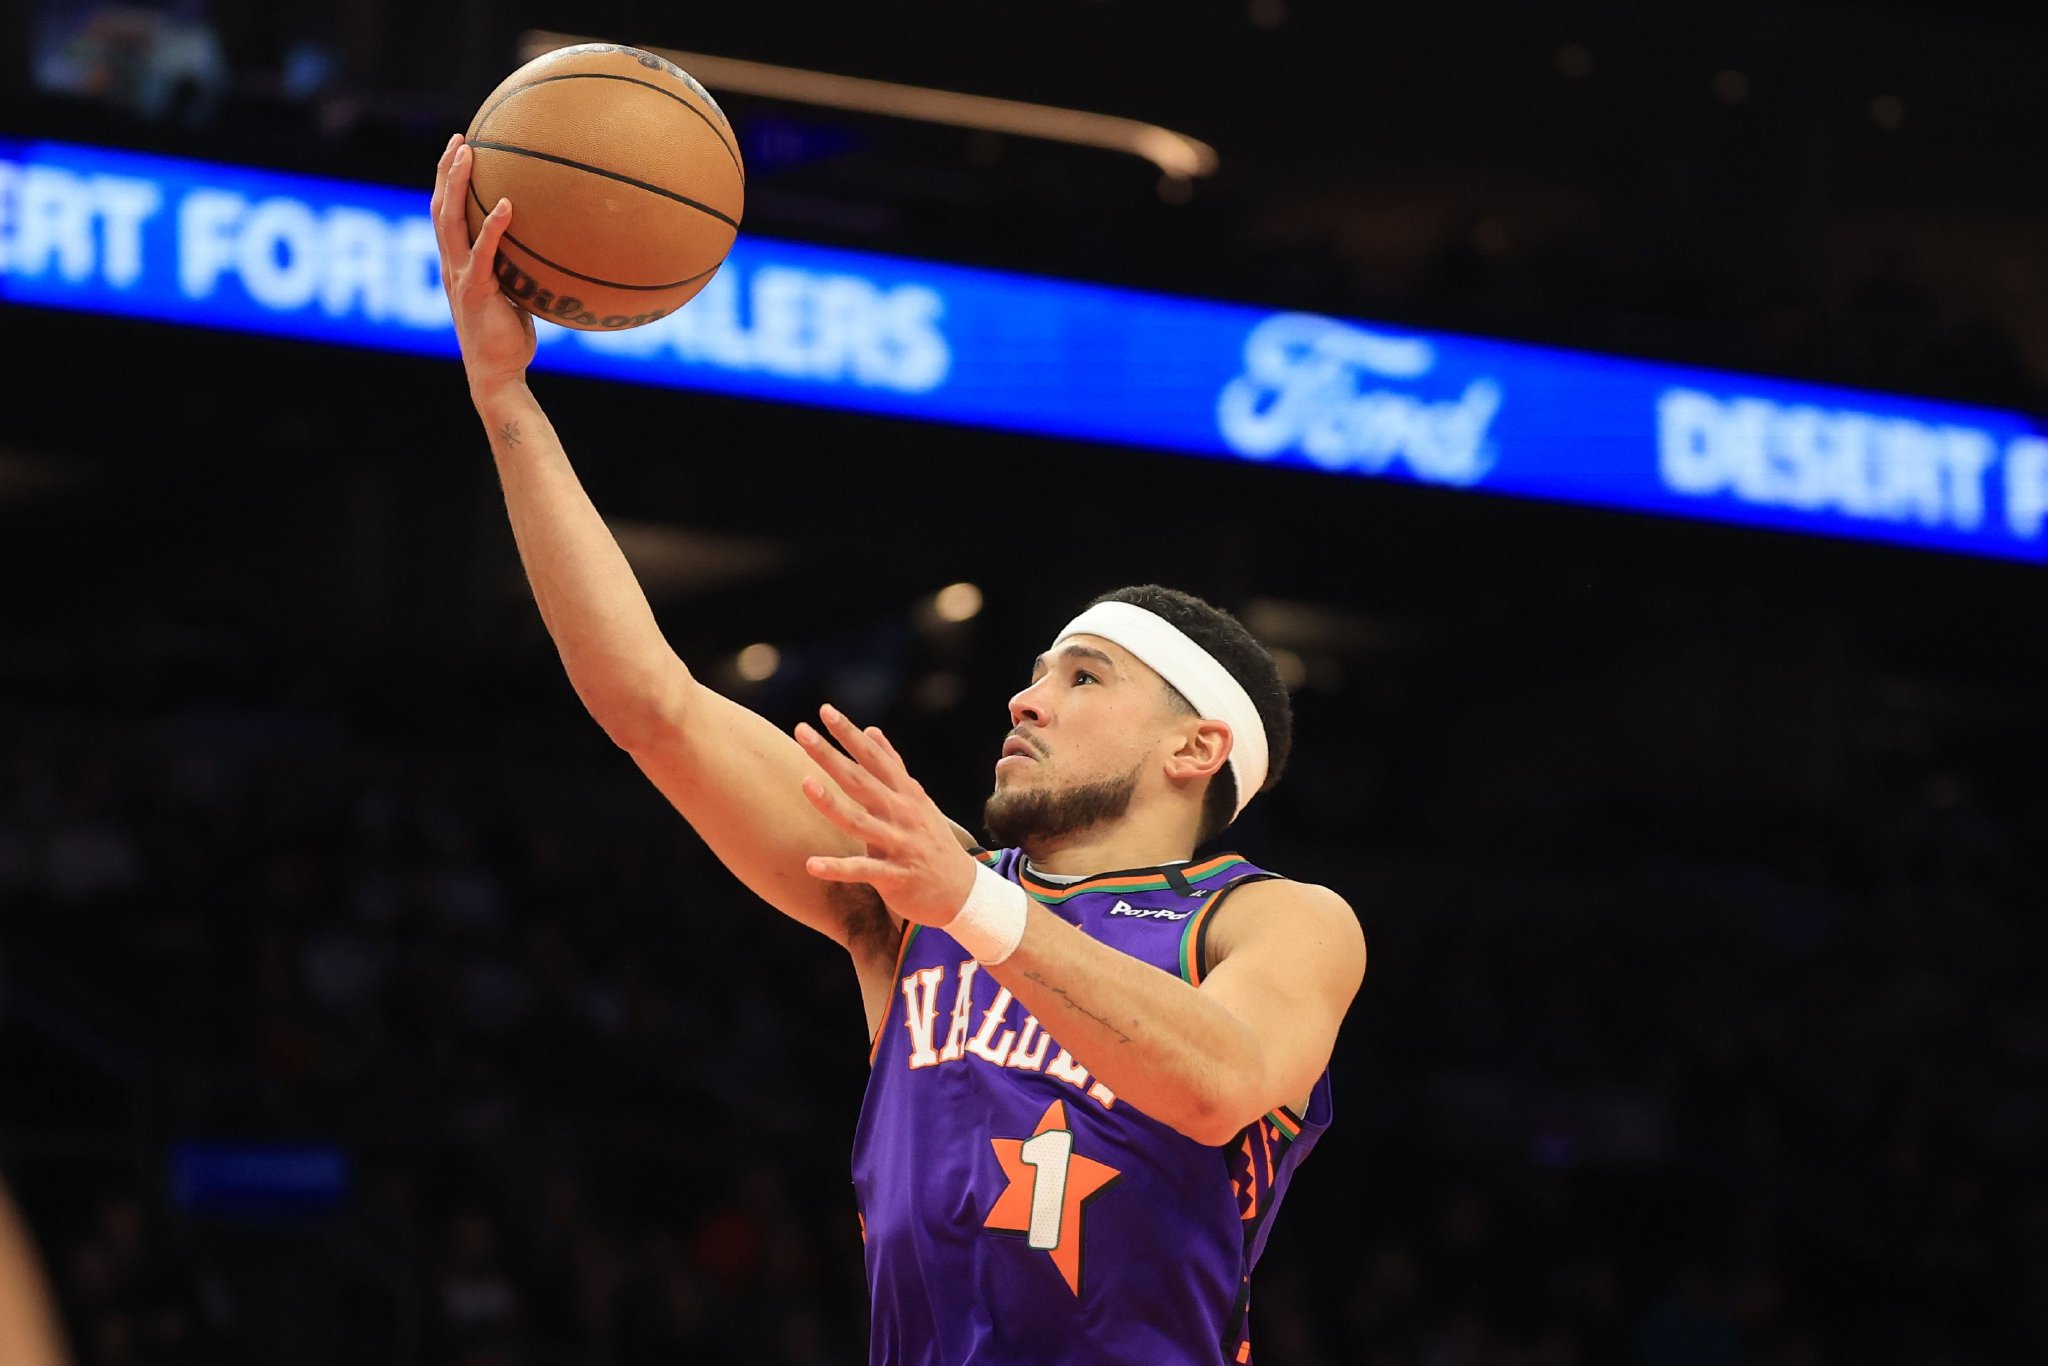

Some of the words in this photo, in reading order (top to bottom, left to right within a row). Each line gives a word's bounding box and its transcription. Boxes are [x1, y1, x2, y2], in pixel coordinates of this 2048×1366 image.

[178, 188, 452, 327] FORD
[1216, 312, 1502, 486] Ford
[1657, 388, 1996, 532] DESERT
[1021, 1130, 1074, 1250] 1
